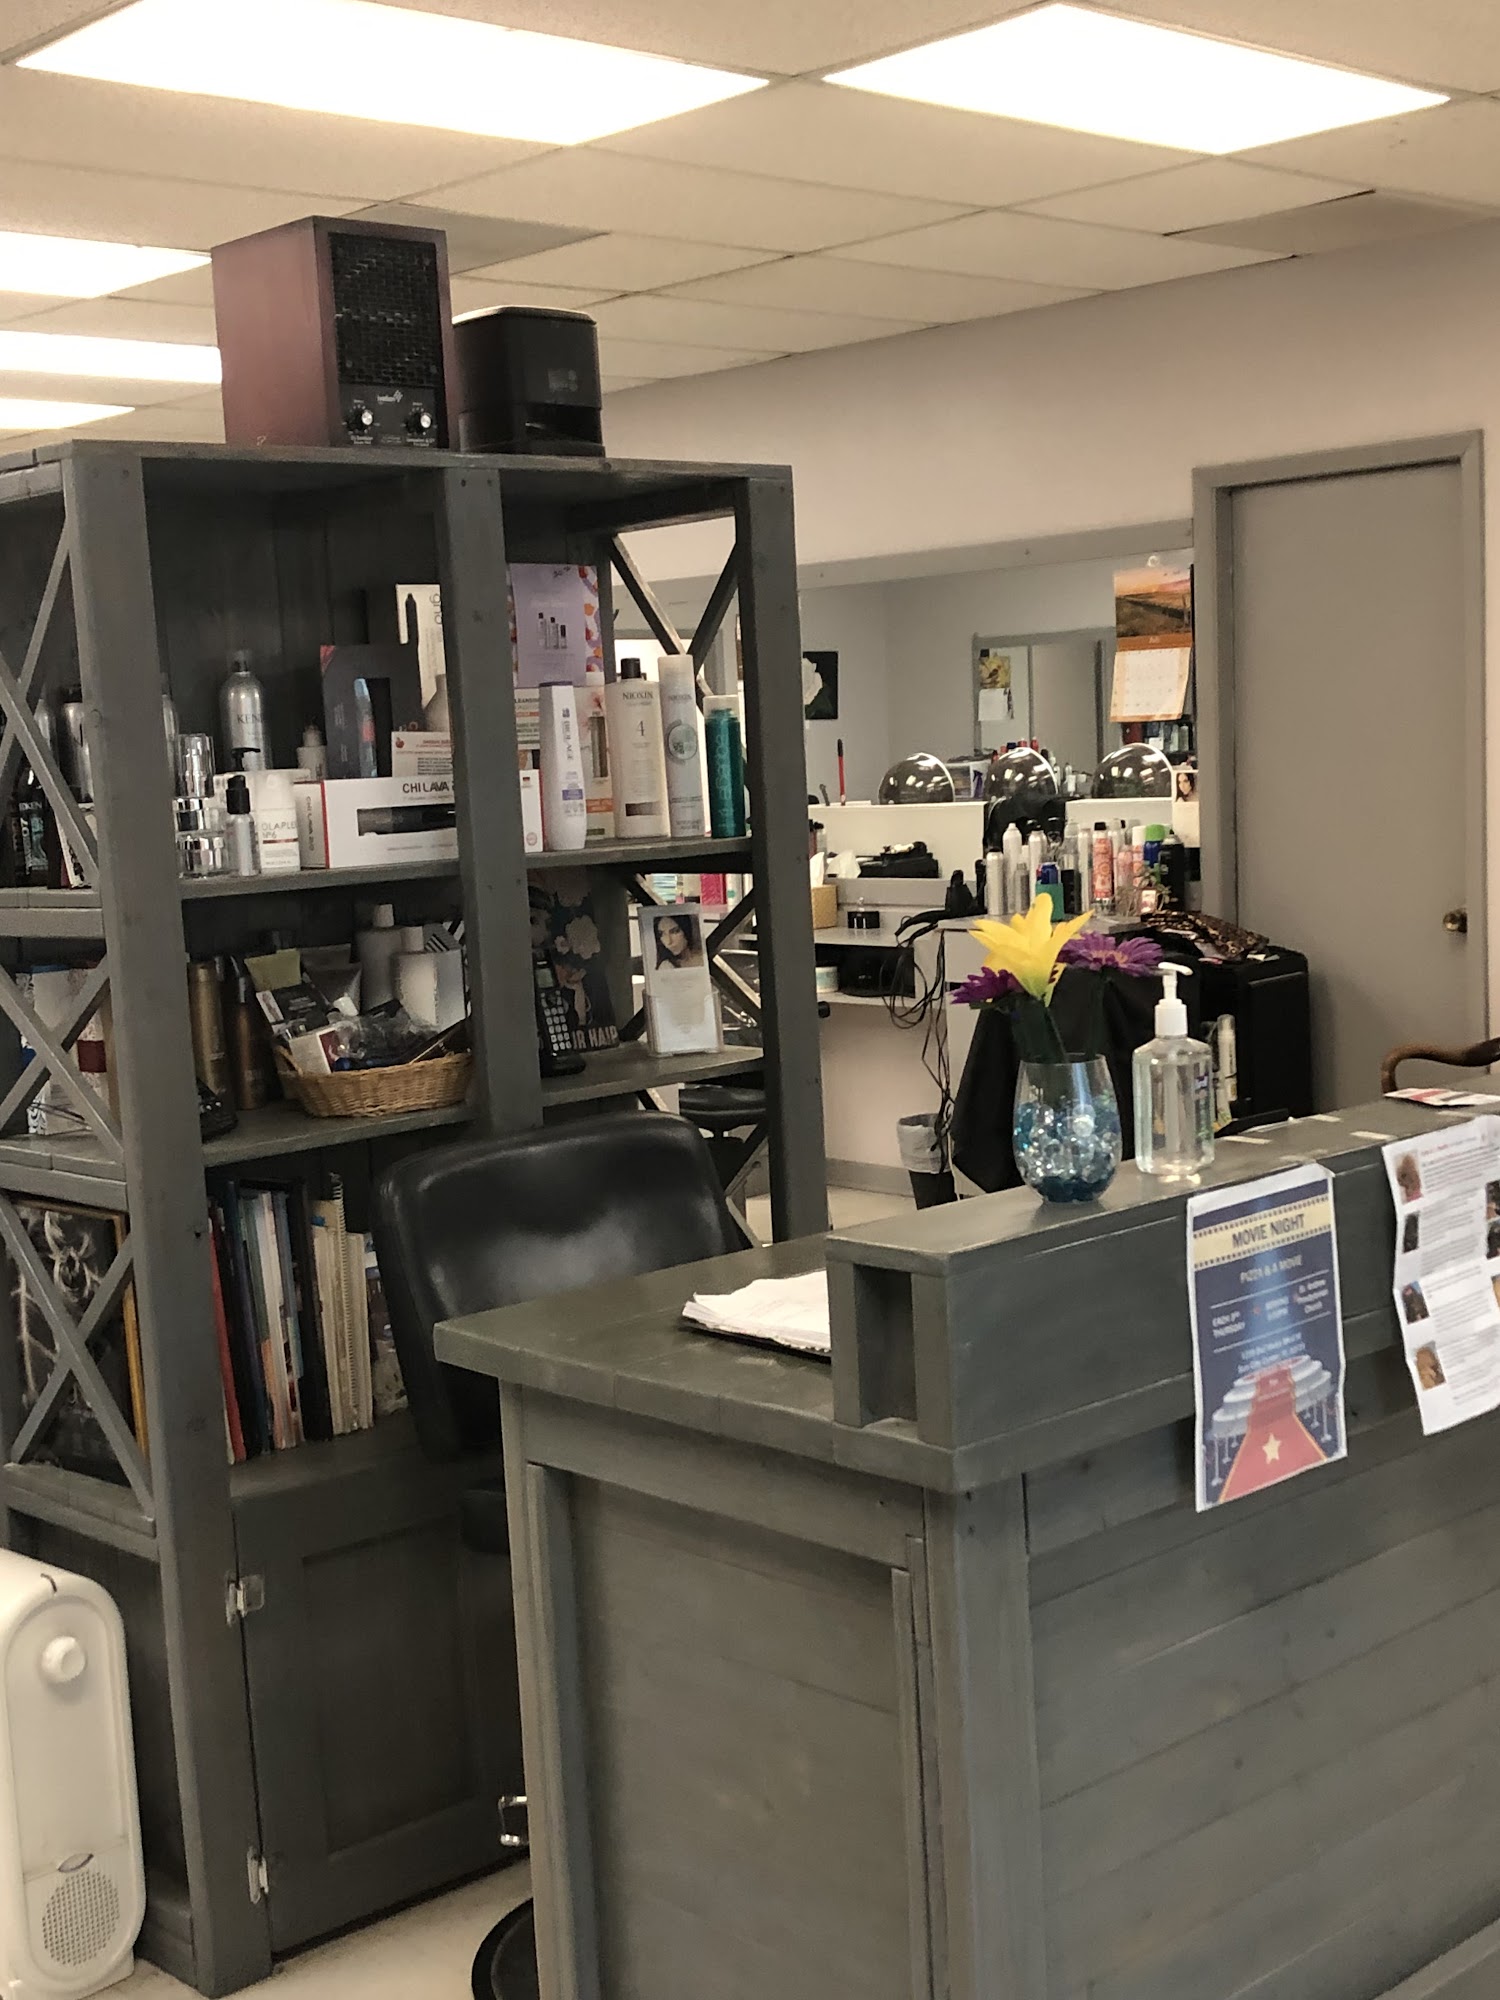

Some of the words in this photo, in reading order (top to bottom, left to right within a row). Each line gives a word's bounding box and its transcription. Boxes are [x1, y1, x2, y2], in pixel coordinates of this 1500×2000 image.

[622, 691, 654, 701] NIOXIN
[636, 720, 645, 737] 4
[402, 783, 421, 793] CHI
[422, 781, 450, 793] LAVA
[1232, 1223, 1267, 1249] MOVIE
[1270, 1213, 1305, 1237] NIGHT
